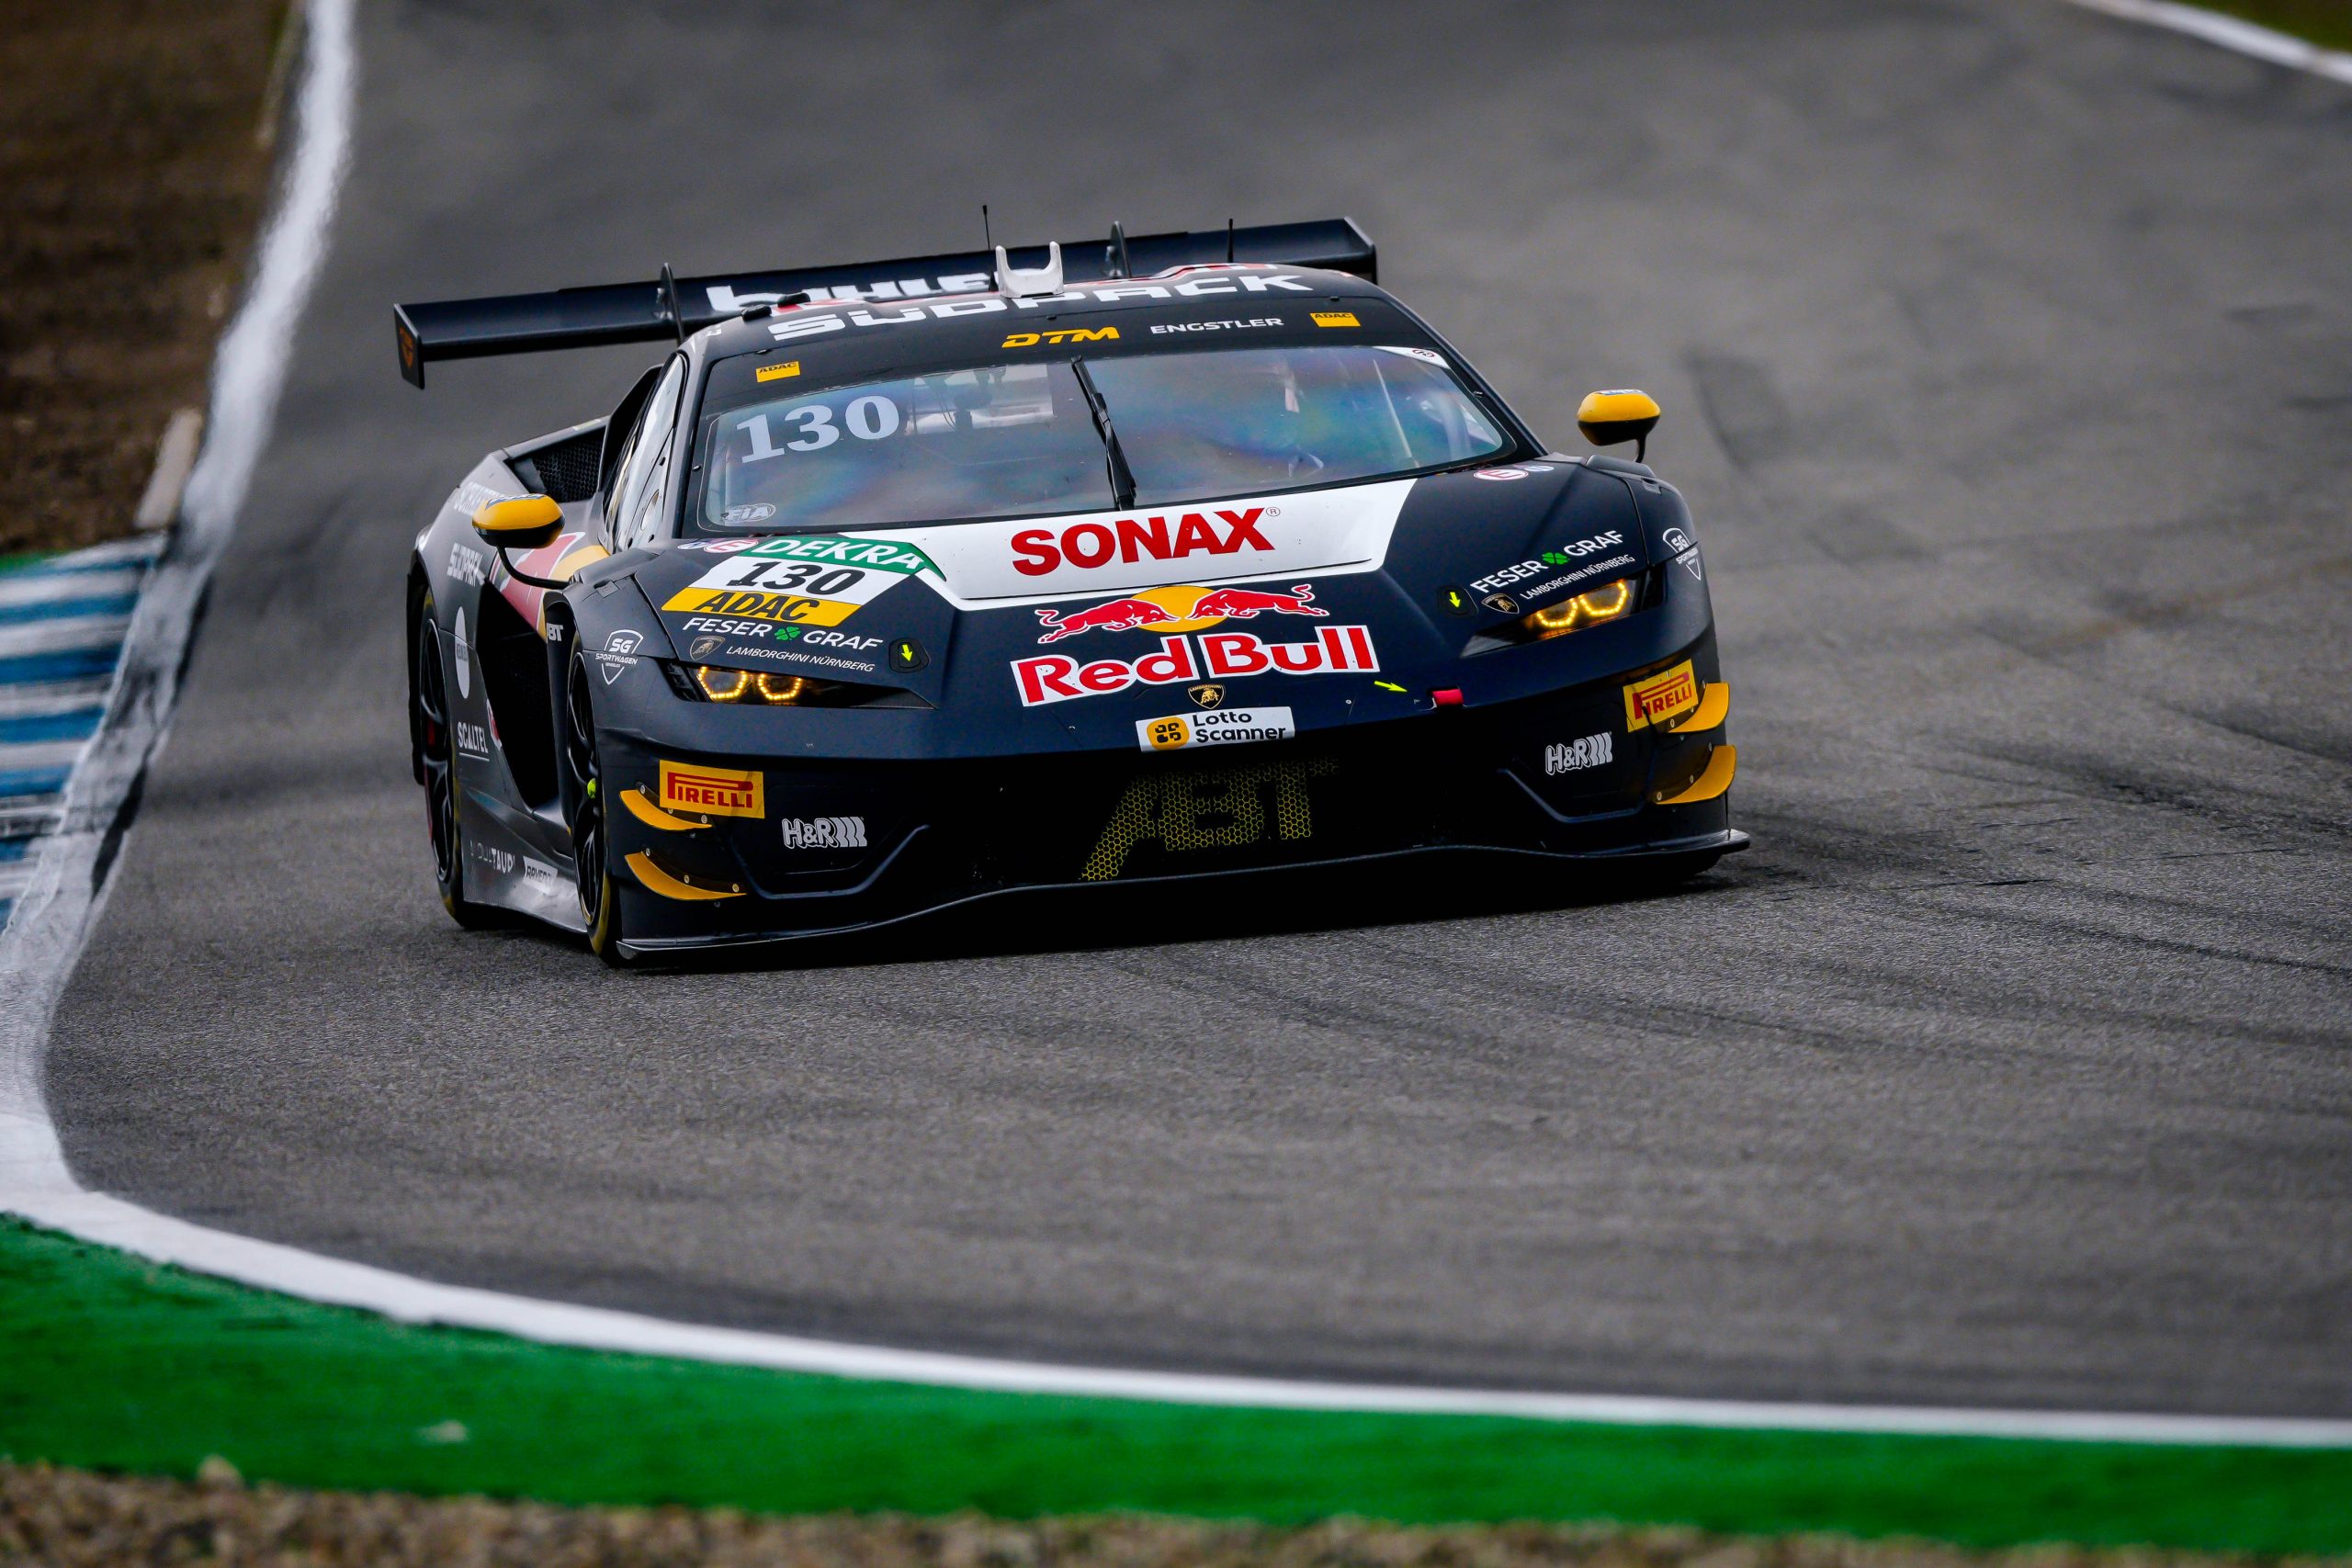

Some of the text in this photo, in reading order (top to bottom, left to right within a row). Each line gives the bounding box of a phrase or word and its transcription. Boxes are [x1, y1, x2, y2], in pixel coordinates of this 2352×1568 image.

[1001, 326, 1121, 348] DTM
[1150, 317, 1284, 335] ENGSTLER
[759, 362, 797, 374] ADAC
[737, 395, 899, 464] 130
[725, 505, 770, 523] FIA
[751, 538, 925, 570] DEKRA
[1011, 507, 1276, 577] SONAX
[1470, 530, 1624, 593] FESER GRAF
[1520, 554, 1635, 600] LAMBORGHINI NÜRNBERG
[726, 561, 865, 595] 130
[693, 592, 820, 622] ADAC
[608, 637, 634, 653] SG
[683, 617, 883, 650] FESER GRAF
[595, 653, 639, 665] SPORTWAGEN
[726, 646, 876, 672] LAMBORGHINI NÜRNBERG
[1011, 625, 1380, 707] Red Bull
[1632, 671, 1692, 720] PIRELLI
[1193, 711, 1252, 728] Lotto
[1195, 726, 1286, 744] Scanner
[1545, 738, 1592, 775] H&R
[667, 772, 754, 808] PIRELLI
[782, 818, 842, 849] H&R
[1081, 757, 1340, 882] ABT
